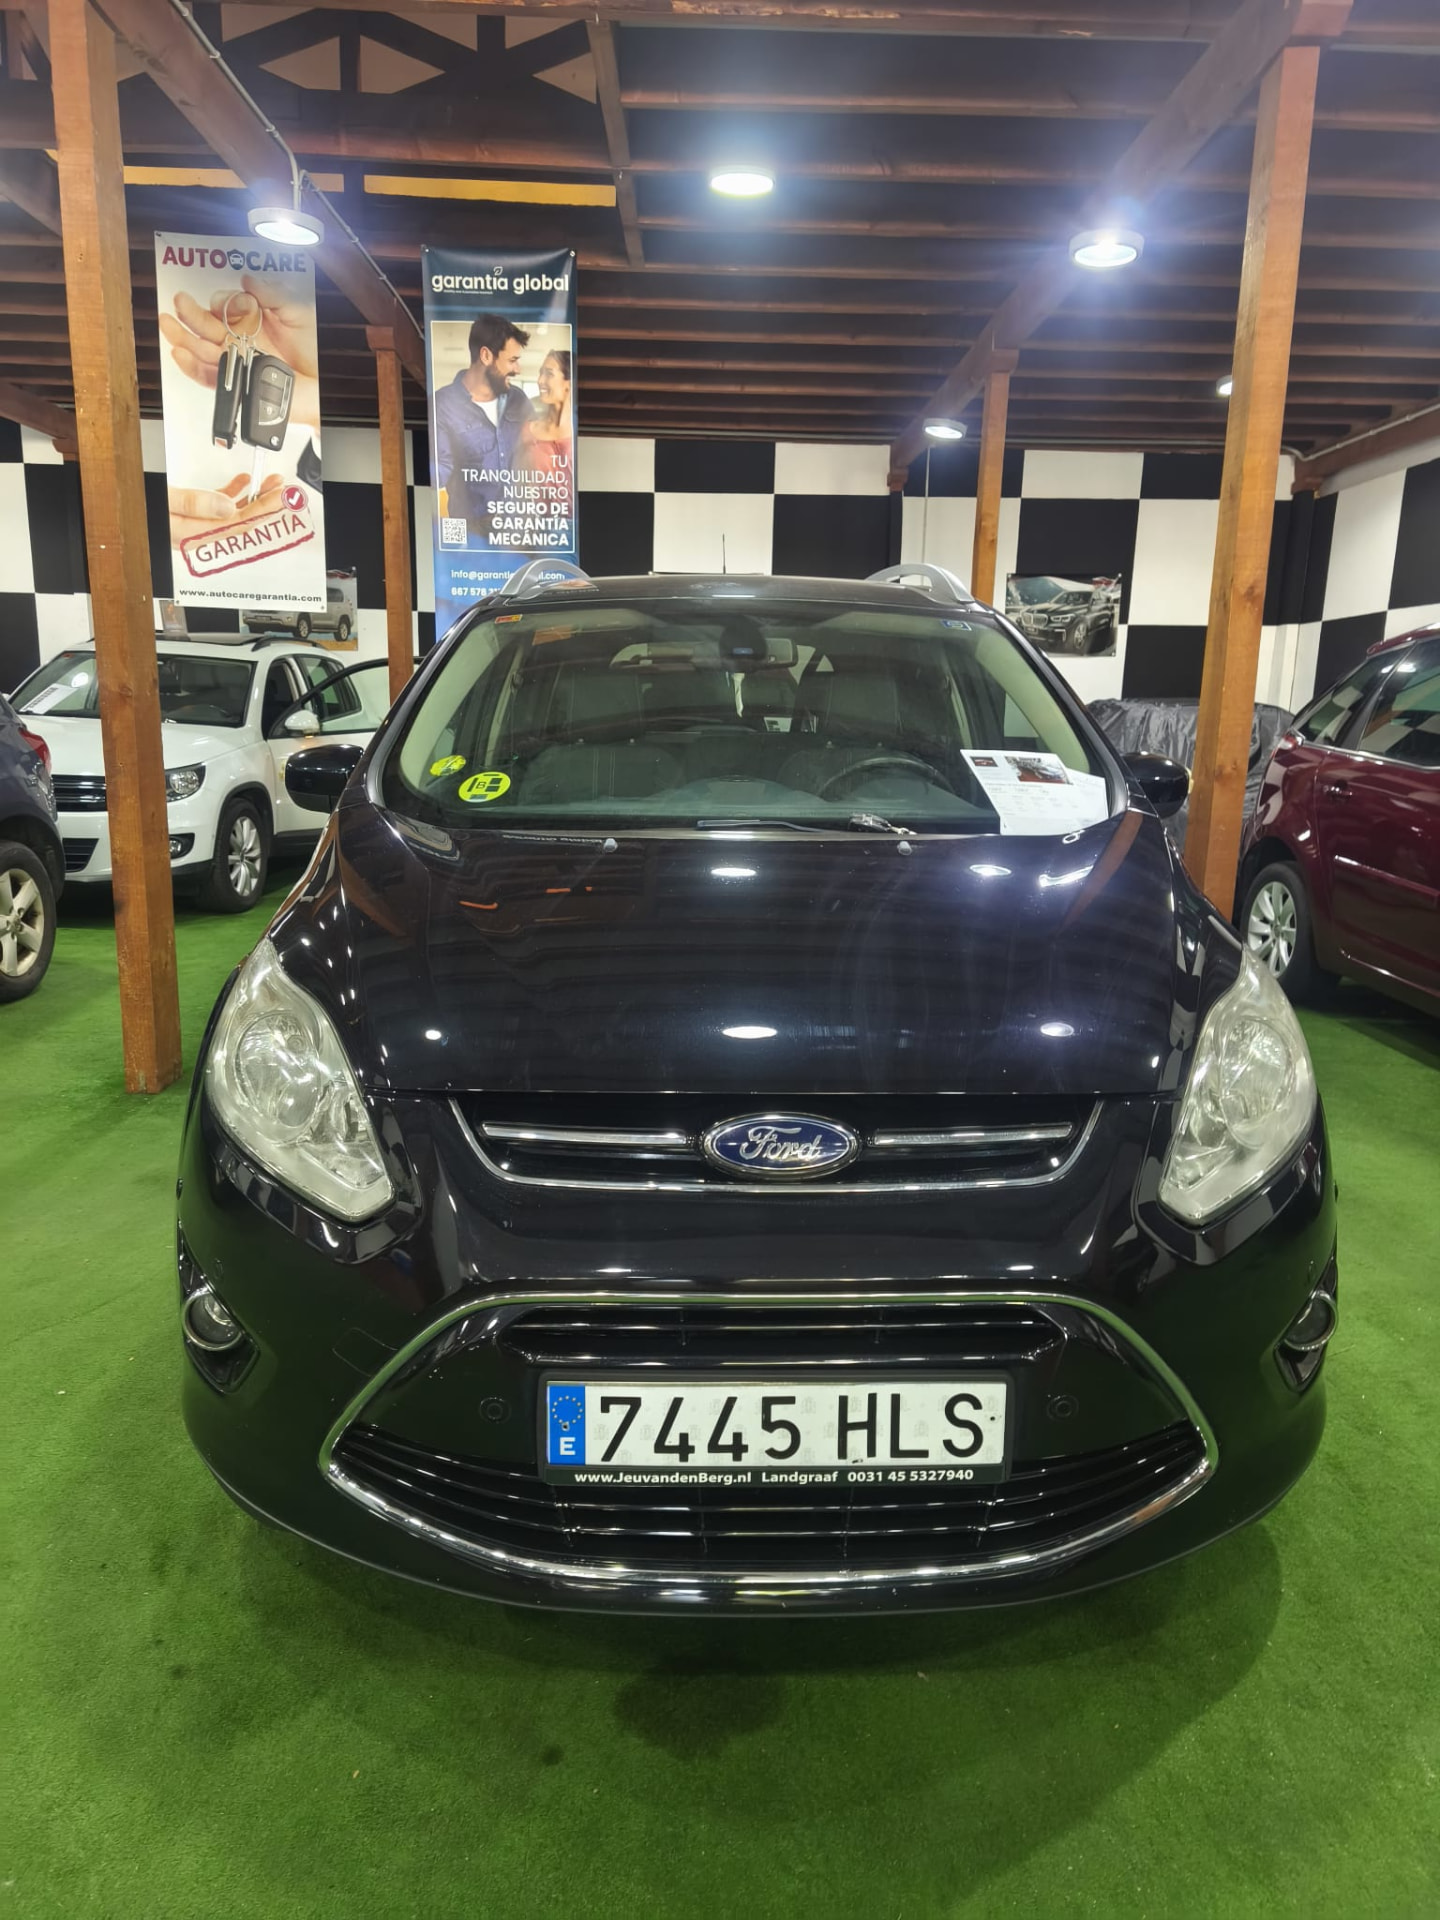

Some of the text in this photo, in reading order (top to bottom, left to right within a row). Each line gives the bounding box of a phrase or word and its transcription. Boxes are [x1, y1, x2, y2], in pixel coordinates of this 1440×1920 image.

[513, 274, 569, 295] global
[550, 455, 568, 468] TU
[461, 469, 569, 485] TRANQUILIDAD,
[504, 486, 569, 499] NUESTRO
[487, 501, 569, 515] SEGURO DE
[492, 515, 569, 531] GARANTÍA
[195, 514, 306, 562] GARANTÍA
[489, 531, 569, 546] MECÁNICA
[179, 590, 322, 602] www.autocaregarantia.com
[476, 781, 487, 789] B
[739, 1125, 823, 1160] Ford
[559, 1392, 984, 1462] E 7445 HLS
[574, 1469, 974, 1485] www.JeuvandenBerg.nl Landgraaf 0031 45 5327940
